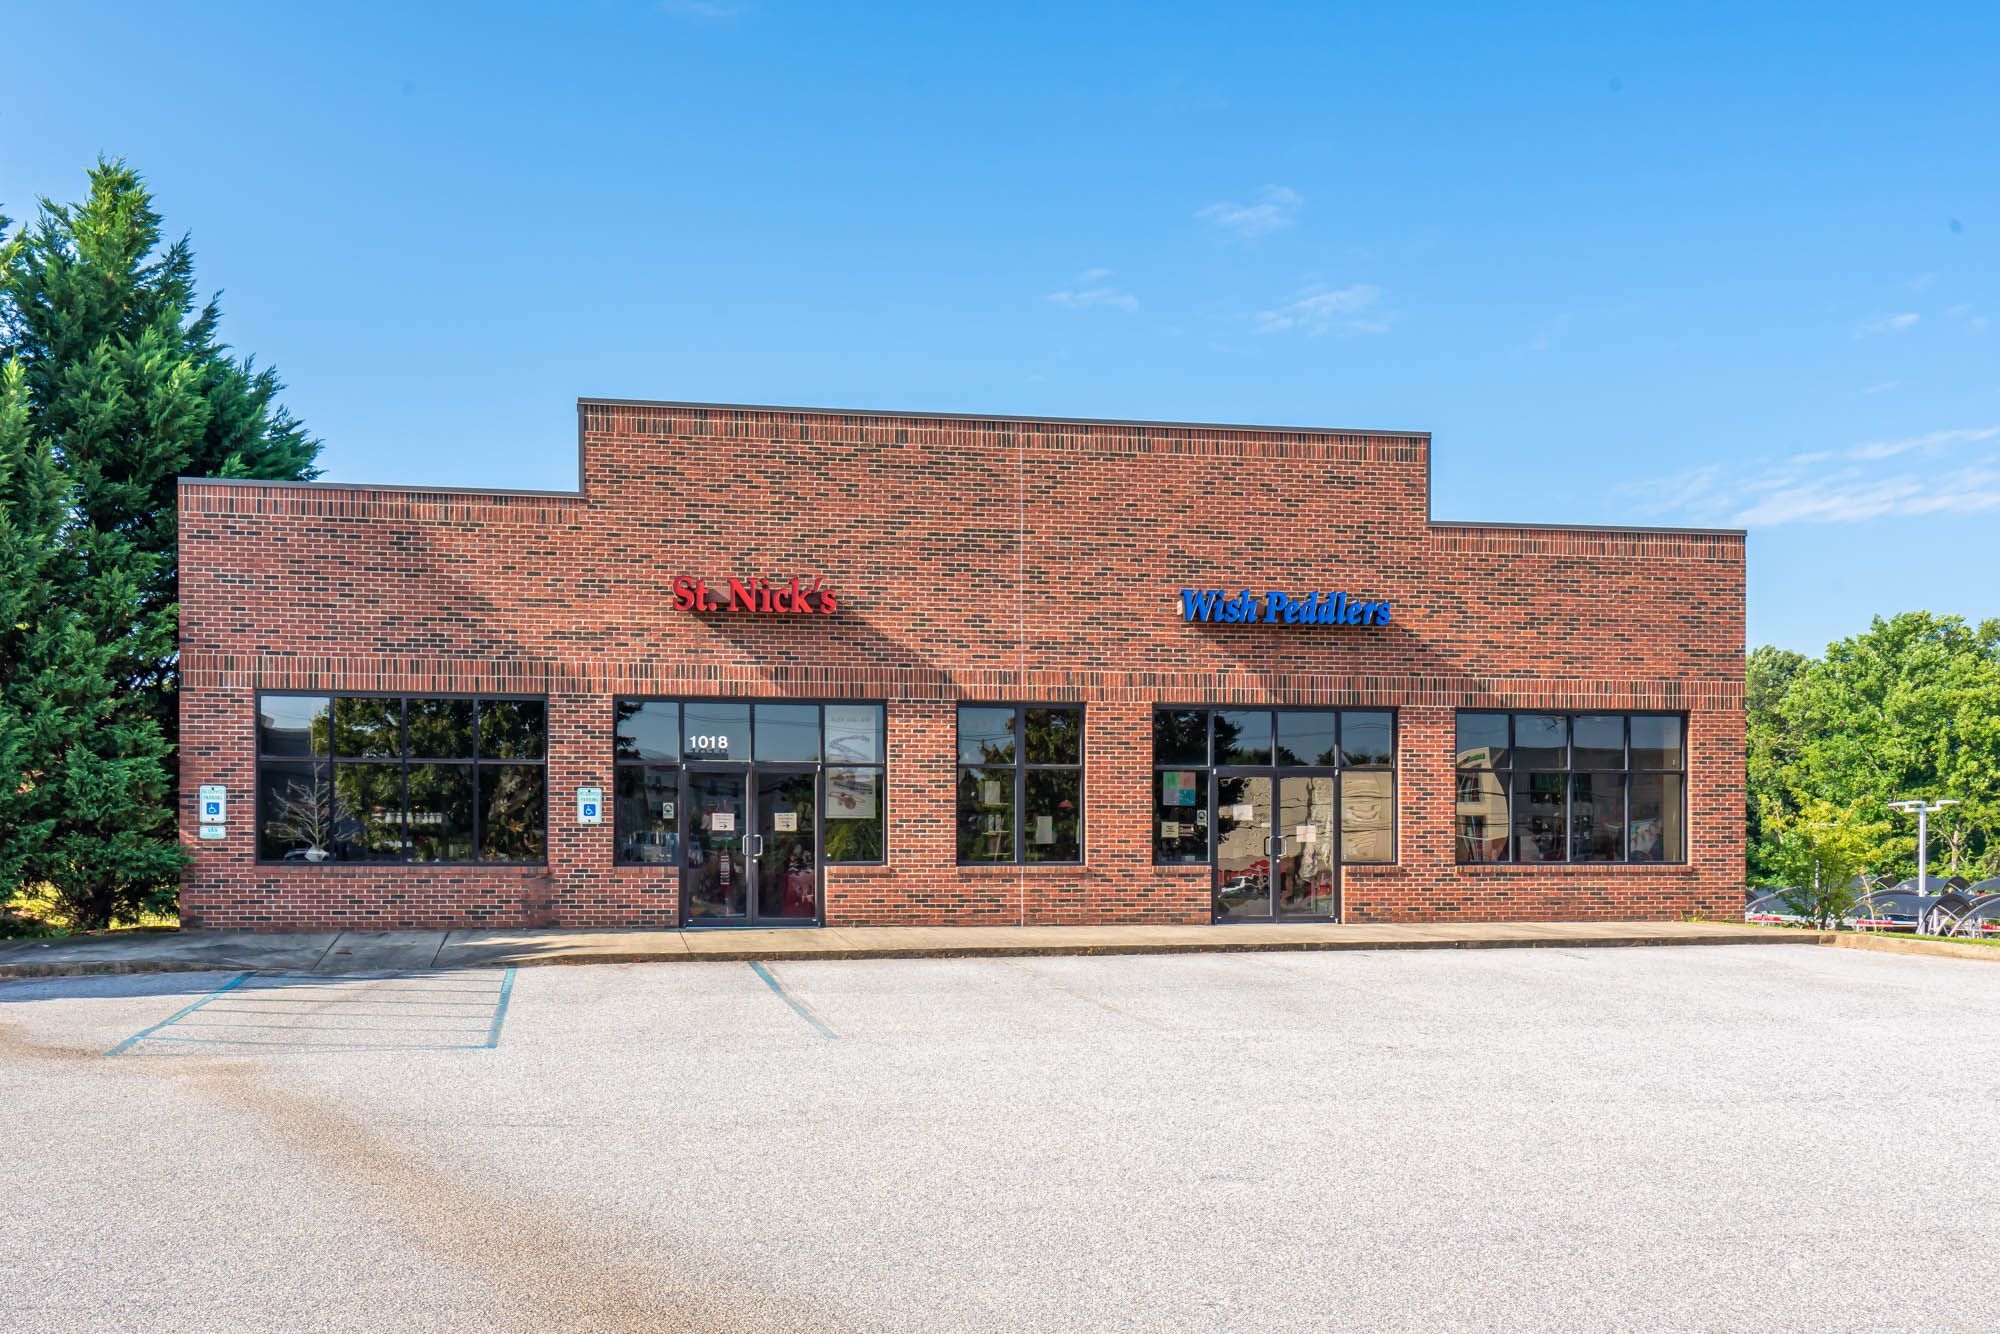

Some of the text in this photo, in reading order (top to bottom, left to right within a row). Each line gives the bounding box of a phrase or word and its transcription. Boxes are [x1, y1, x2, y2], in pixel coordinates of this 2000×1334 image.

[672, 576, 837, 614] St. Nick's
[1180, 588, 1391, 626] Wish Peddlers
[689, 735, 728, 749] 1018
